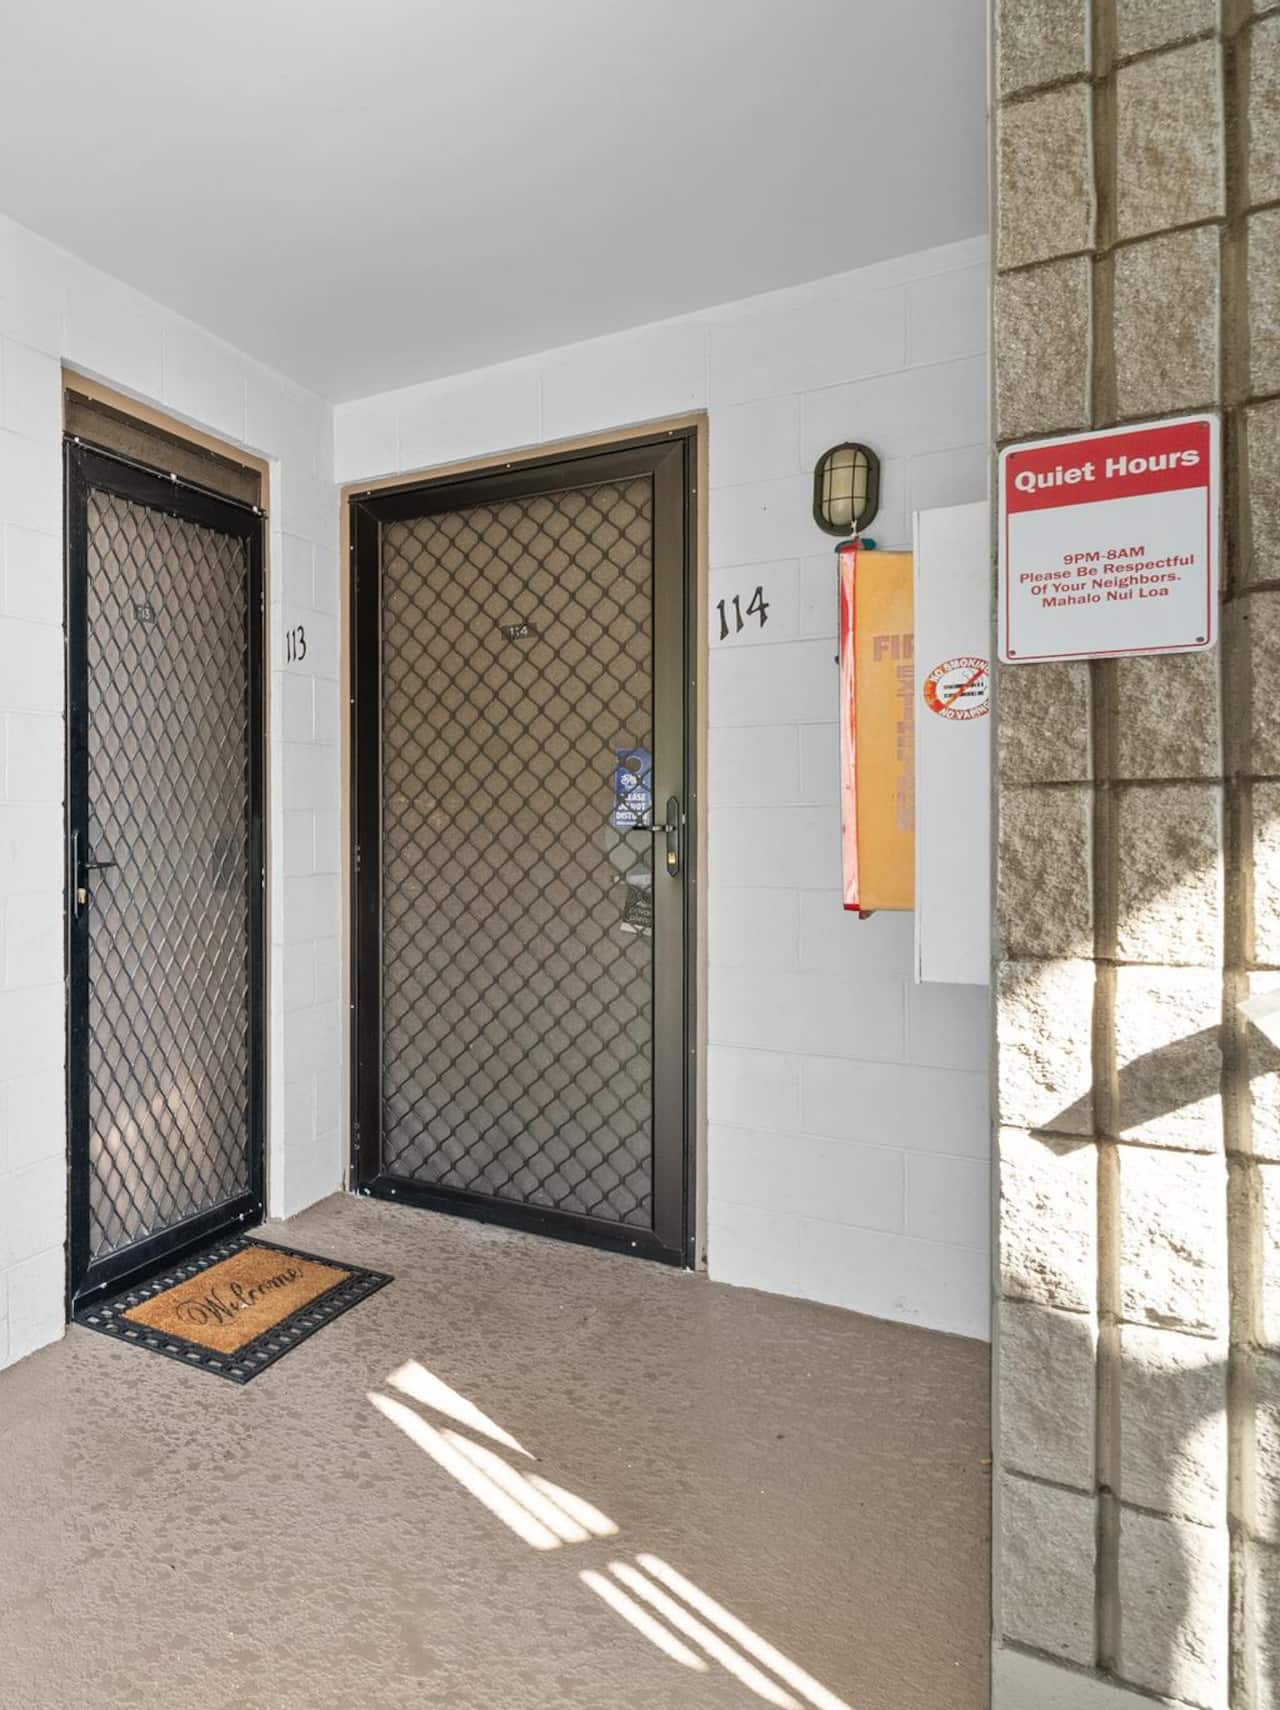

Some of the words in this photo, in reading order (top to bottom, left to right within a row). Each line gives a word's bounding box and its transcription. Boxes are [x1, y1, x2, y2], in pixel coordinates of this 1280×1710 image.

[1014, 462, 1096, 493] Quiet
[1105, 449, 1201, 478] Hours
[1020, 571, 1071, 583] Please
[1077, 566, 1098, 577] Be
[1103, 554, 1195, 574] Respectful
[1063, 546, 1145, 565] 9PM-8AM
[1031, 583, 1048, 595] Of
[1052, 582, 1086, 593] Your
[1091, 573, 1182, 589] Neighbors.
[1042, 594, 1101, 607] Mahalo
[1106, 589, 1133, 601] Nui
[1139, 588, 1169, 598] Loa
[716, 586, 769, 641] 114
[286, 625, 306, 664] 113
